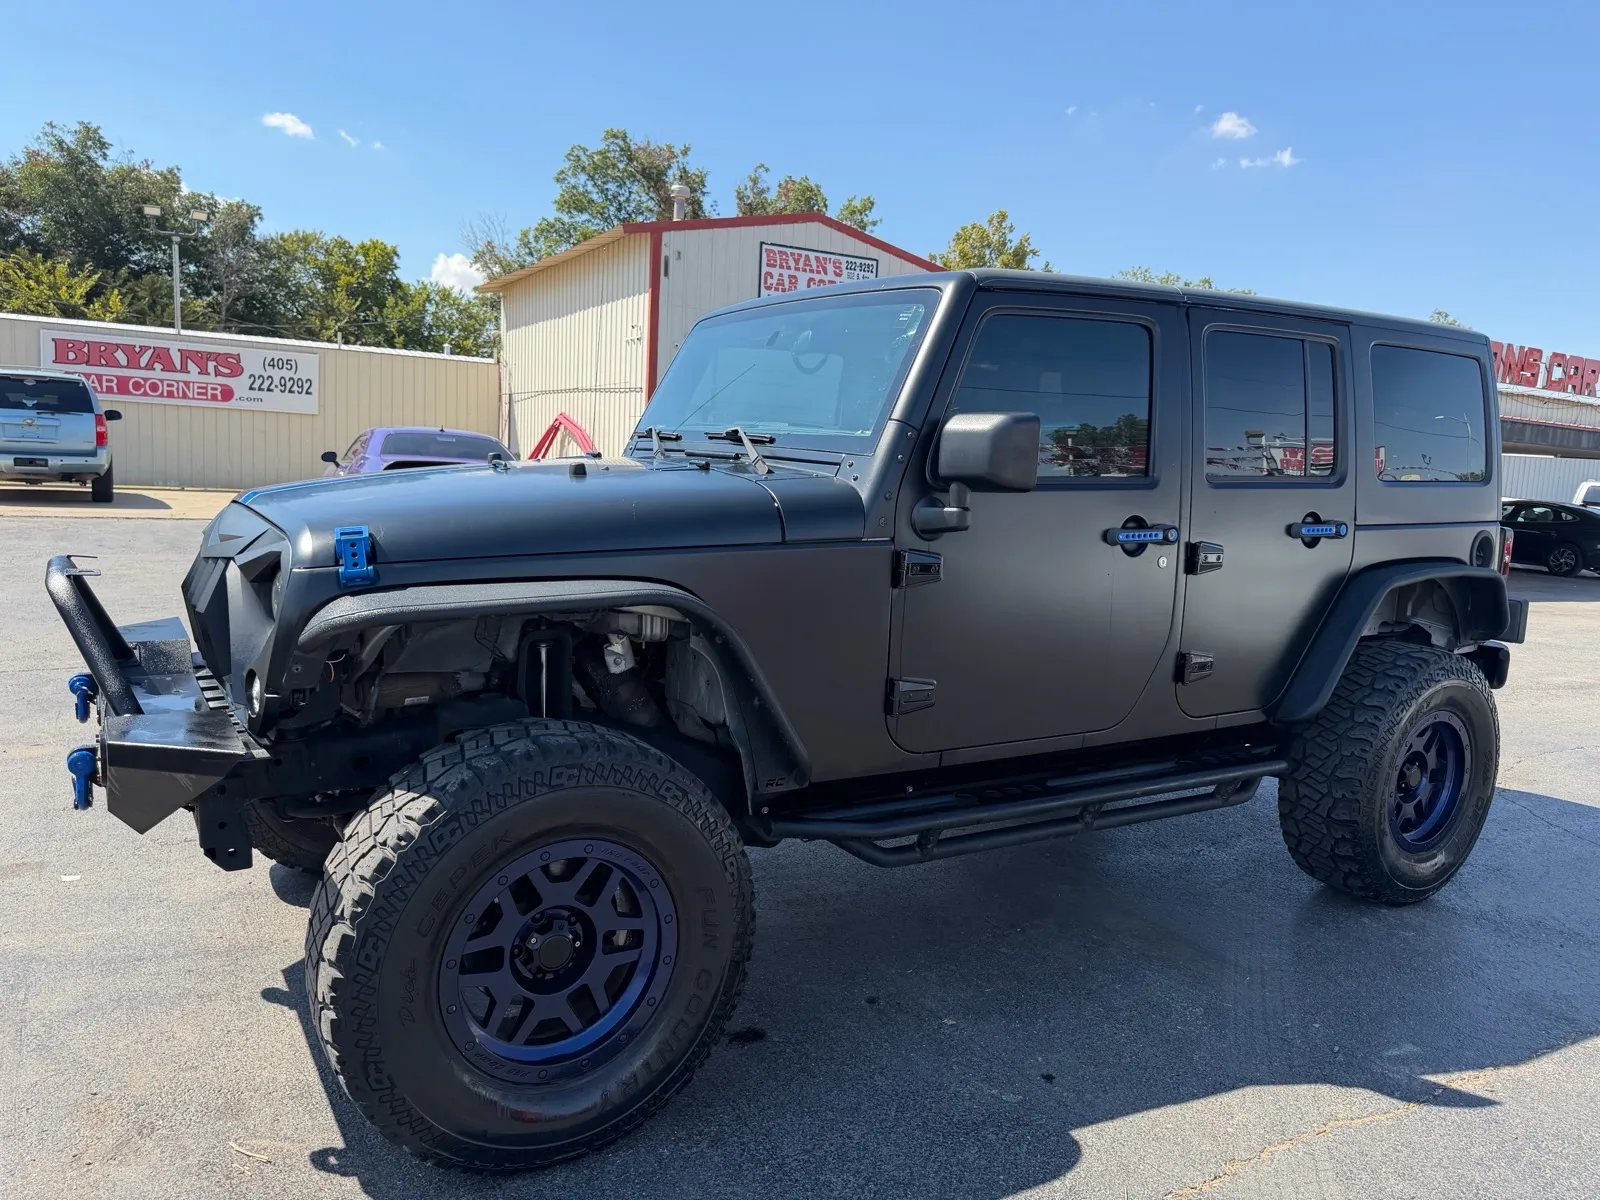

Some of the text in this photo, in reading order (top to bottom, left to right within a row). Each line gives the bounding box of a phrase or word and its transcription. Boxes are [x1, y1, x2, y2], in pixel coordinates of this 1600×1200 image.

[764, 248, 844, 277] BRYAN'S
[845, 260, 875, 274] 222-9292
[763, 271, 798, 293] CAR
[52, 338, 244, 378] BRYAN'S
[263, 356, 298, 375] (405)
[84, 374, 222, 401] AR CORNER
[248, 373, 313, 396] 222-9292
